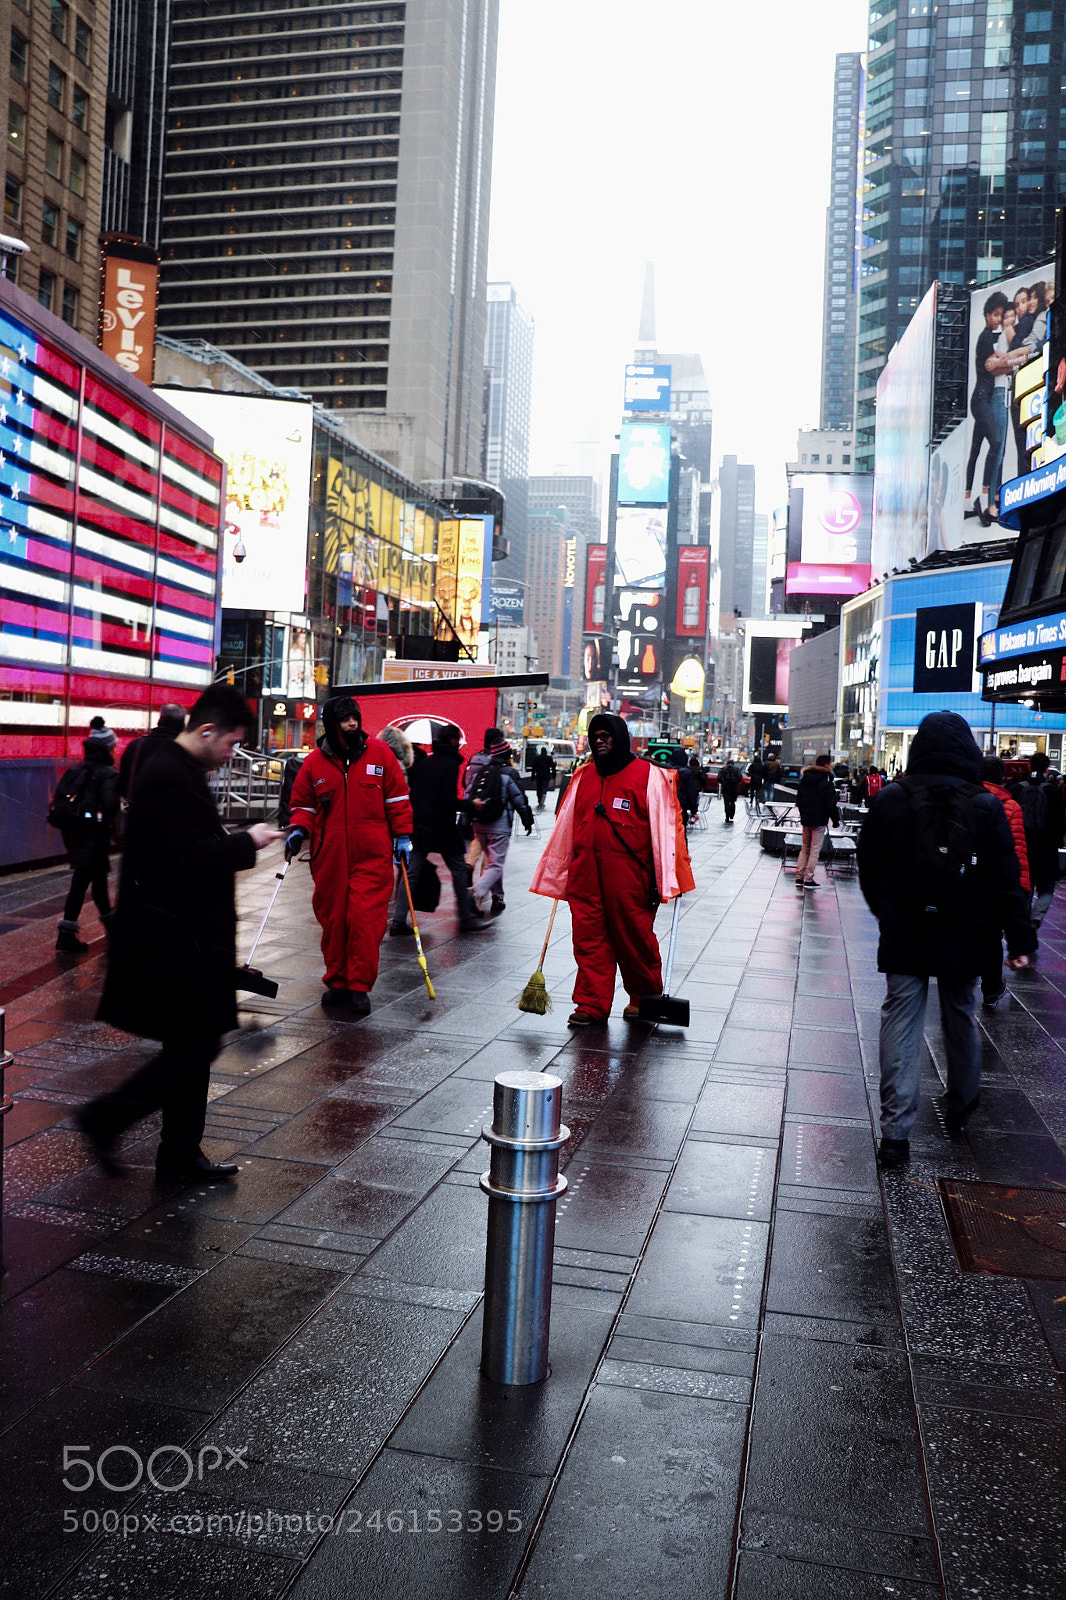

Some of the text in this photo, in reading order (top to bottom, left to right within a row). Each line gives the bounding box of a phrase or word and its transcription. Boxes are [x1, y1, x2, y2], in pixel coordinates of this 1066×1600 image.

[1004, 483, 1023, 506] Good
[1024, 471, 1056, 499] Morning
[461, 555, 481, 565] KING
[462, 545, 479, 554] LION
[565, 536, 577, 588] NOVOTEL
[489, 596, 524, 609] ROZEN
[925, 629, 963, 669] GAP
[999, 632, 1026, 652] Welcome
[1027, 630, 1035, 647] to
[1036, 624, 1058, 645] Times
[1059, 619, 1066, 640] S
[415, 669, 463, 679] ICE & VICE
[994, 669, 1018, 691] proves
[1018, 660, 1052, 686] bargain
